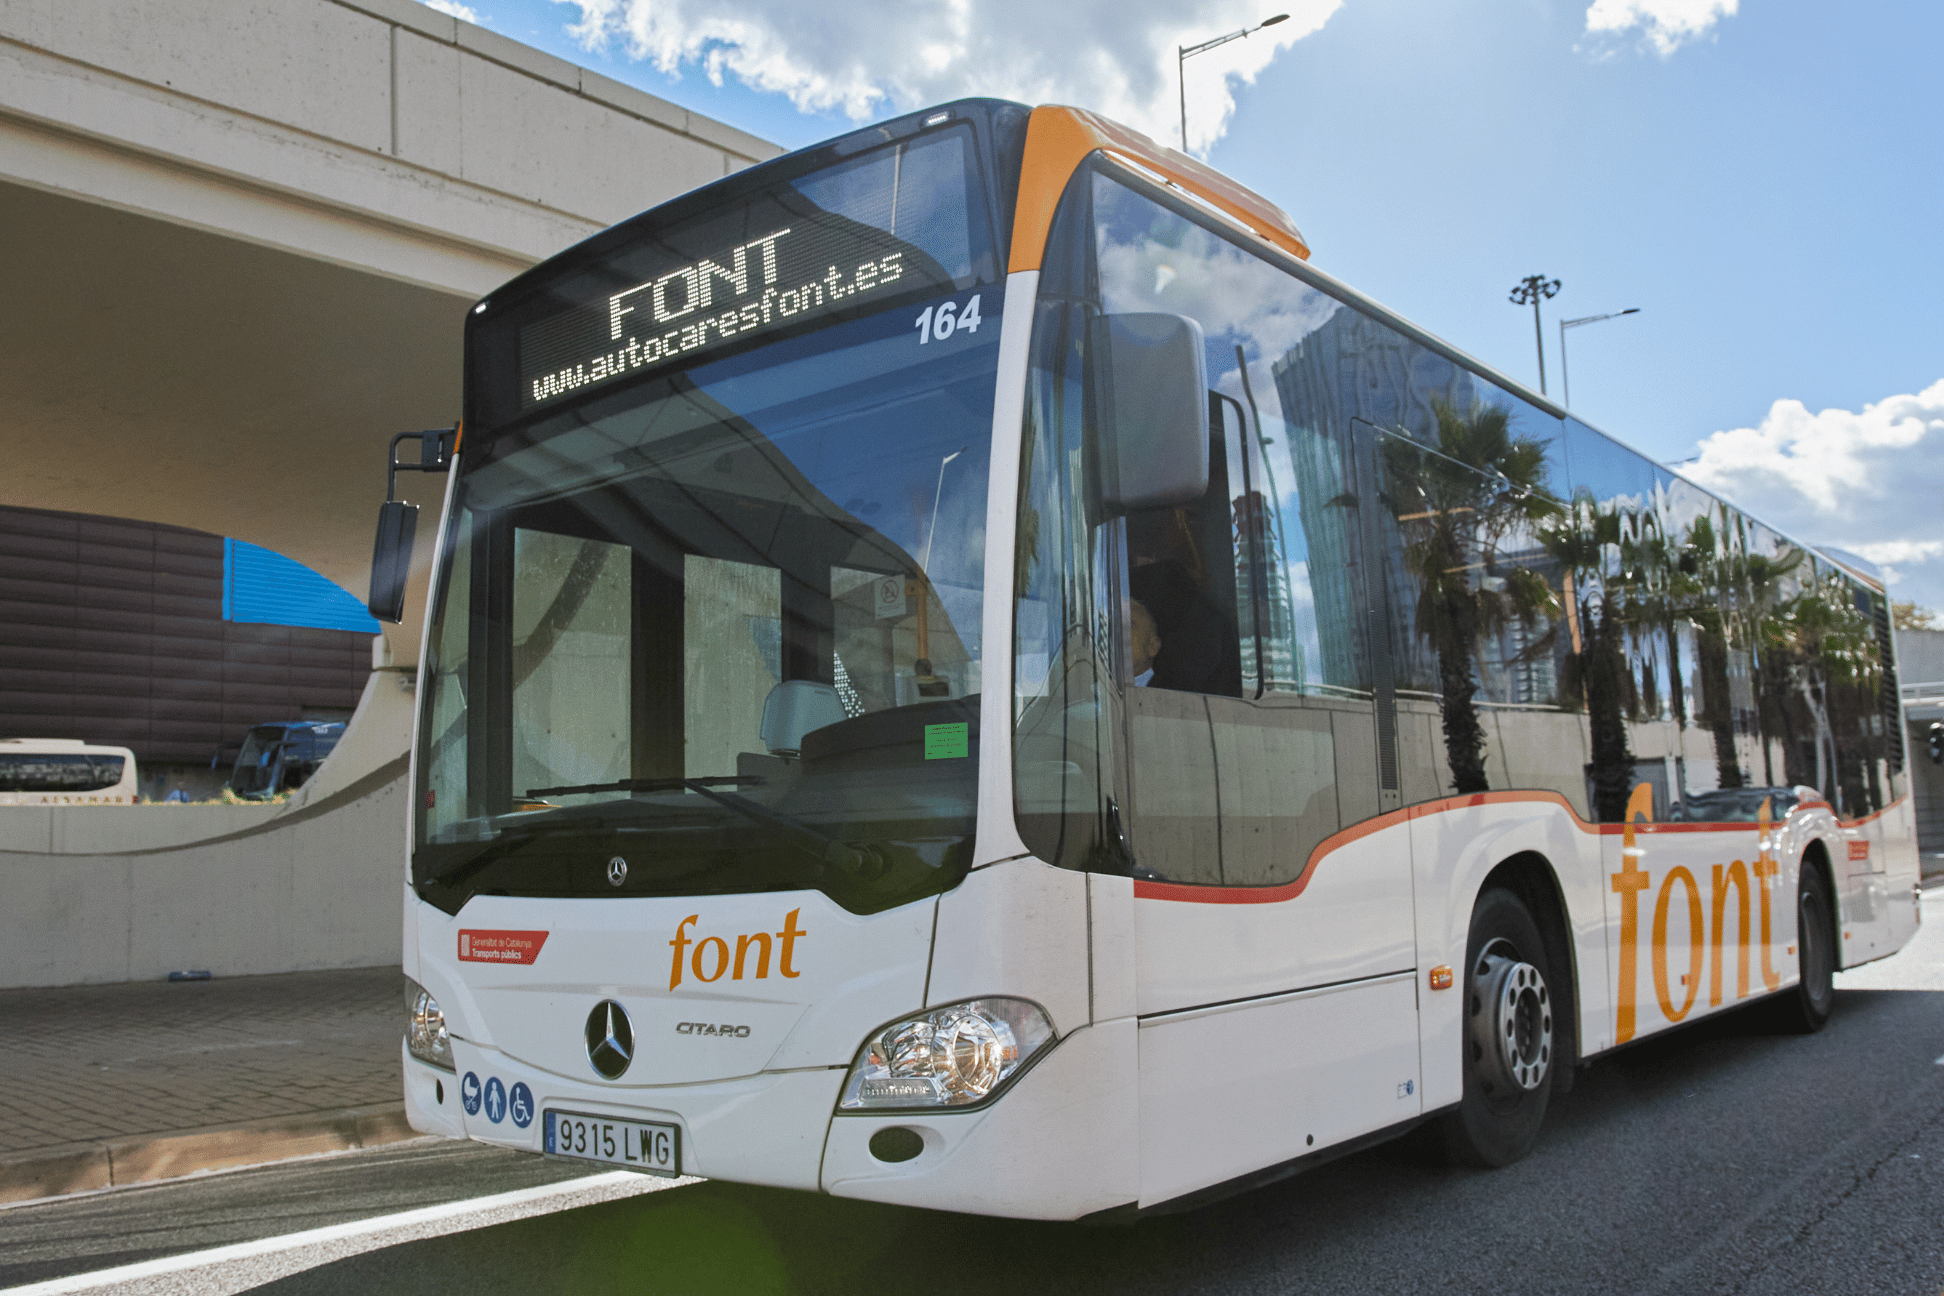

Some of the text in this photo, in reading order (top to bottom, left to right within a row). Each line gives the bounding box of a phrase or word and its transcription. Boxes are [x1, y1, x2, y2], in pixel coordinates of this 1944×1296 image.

[608, 228, 791, 341] FONT
[532, 252, 904, 402] www.autocaresfont.es
[914, 293, 982, 345] 164
[1611, 782, 1780, 1045] font
[472, 936, 498, 948] Generalitat
[506, 937, 532, 950] Catalunya
[472, 948, 521, 960] Transports públics
[668, 907, 807, 993] font
[675, 1021, 752, 1038] CITARO
[560, 1119, 669, 1166] 9315 LWG
